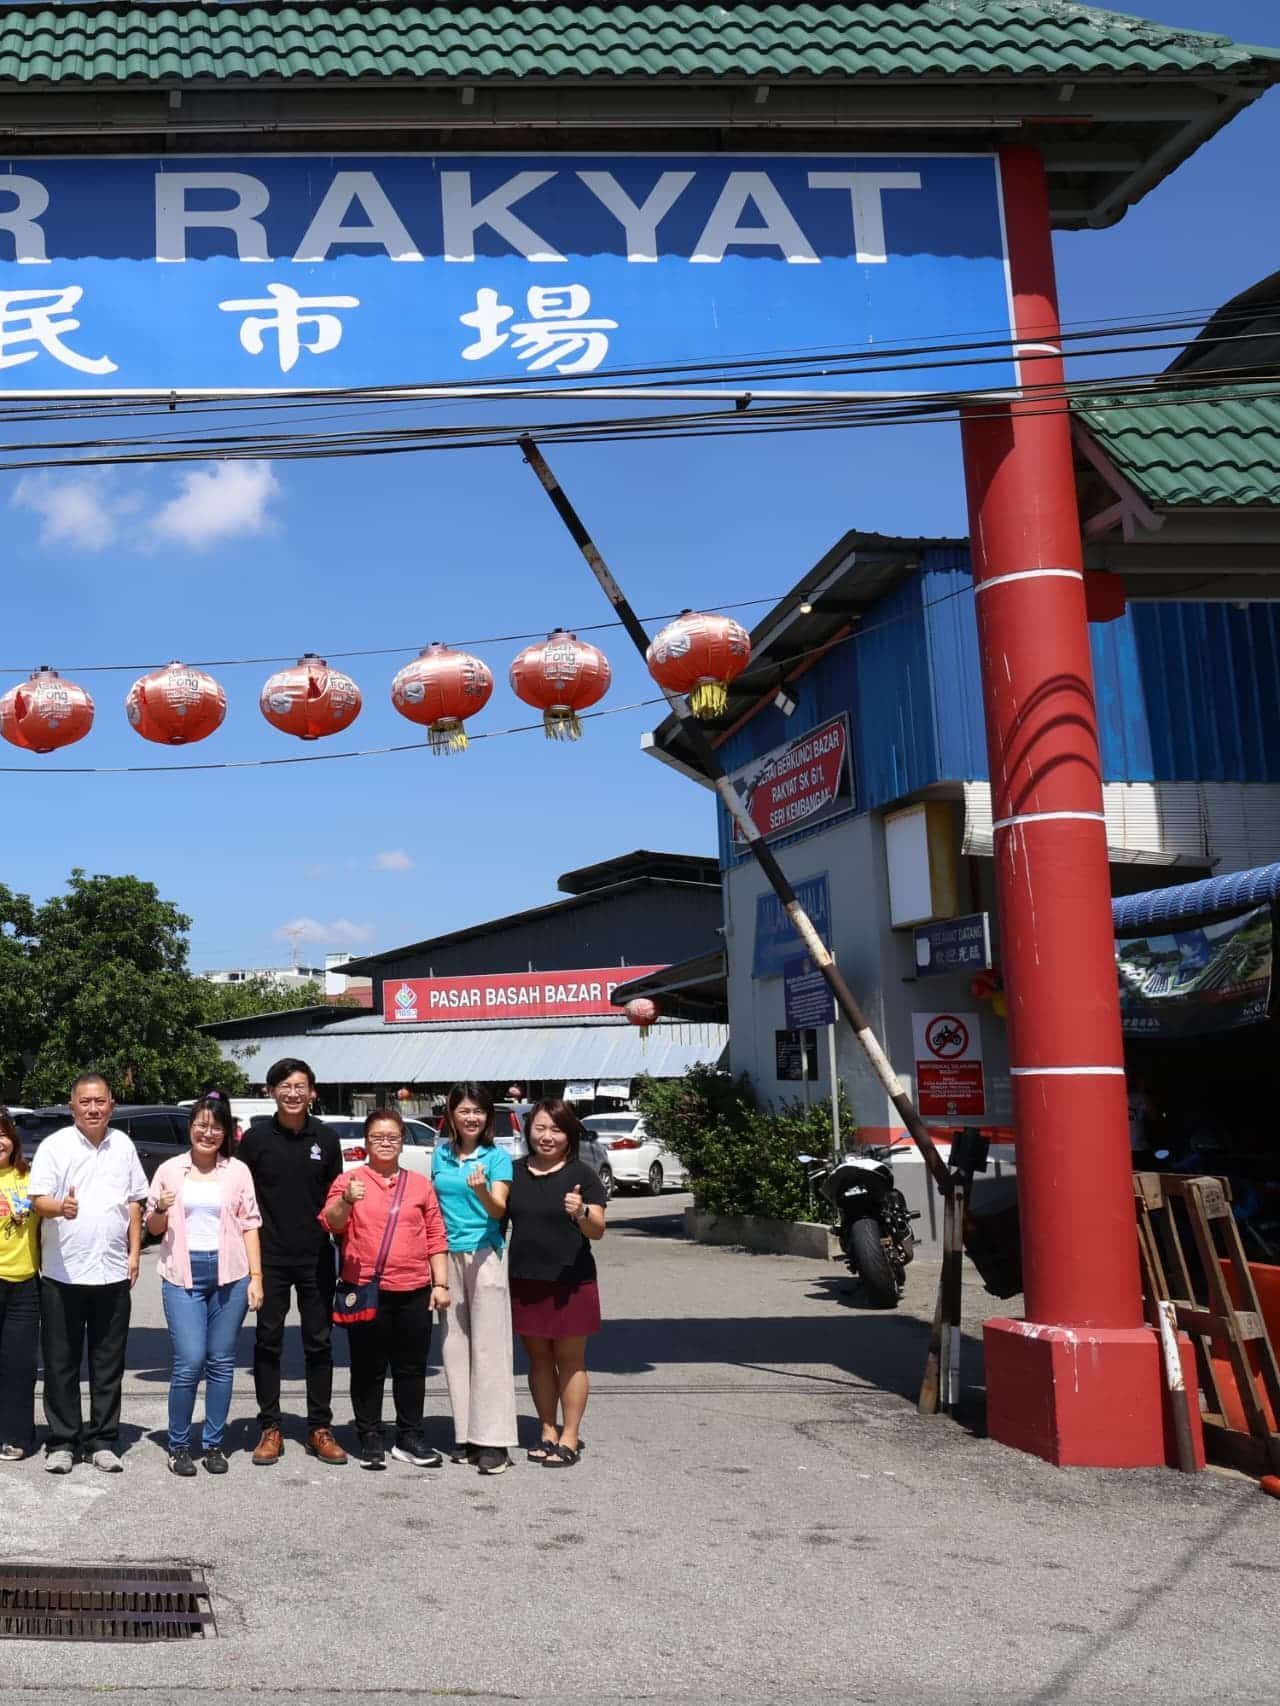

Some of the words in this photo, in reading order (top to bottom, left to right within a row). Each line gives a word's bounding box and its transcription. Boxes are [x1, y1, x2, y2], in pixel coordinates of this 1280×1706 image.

[153, 170, 922, 265] RAKYAT
[777, 744, 813, 776] BERKUNCI
[813, 730, 840, 758] BAZAR
[771, 776, 797, 803] RAKYAT
[799, 772, 810, 791] SK
[769, 807, 786, 829] SERI
[429, 988, 482, 1008] PASAR
[485, 986, 540, 1006] BASAH
[544, 982, 601, 1003] BAZAR
